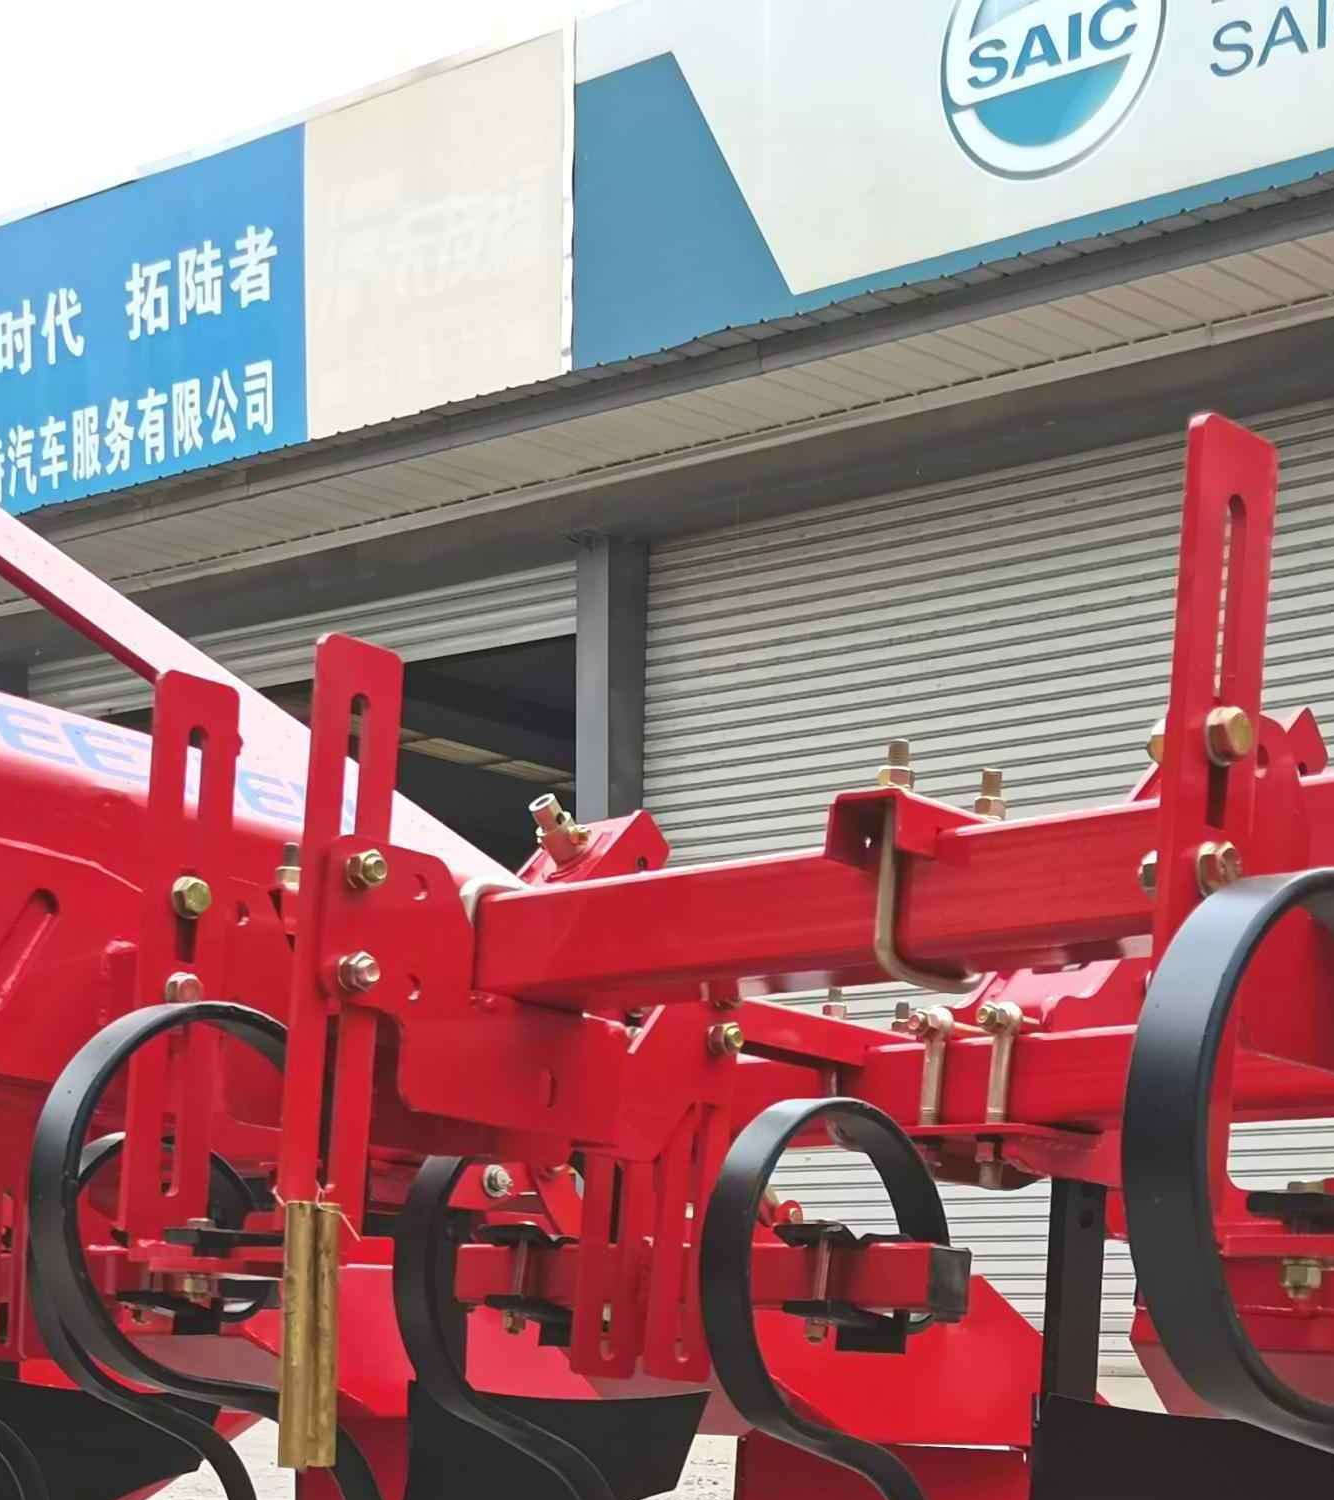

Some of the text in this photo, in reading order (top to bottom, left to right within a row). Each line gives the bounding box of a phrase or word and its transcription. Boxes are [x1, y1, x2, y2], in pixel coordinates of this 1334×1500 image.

[967, 0, 1137, 89] SAIC
[125, 225, 278, 342] 拓陆者
